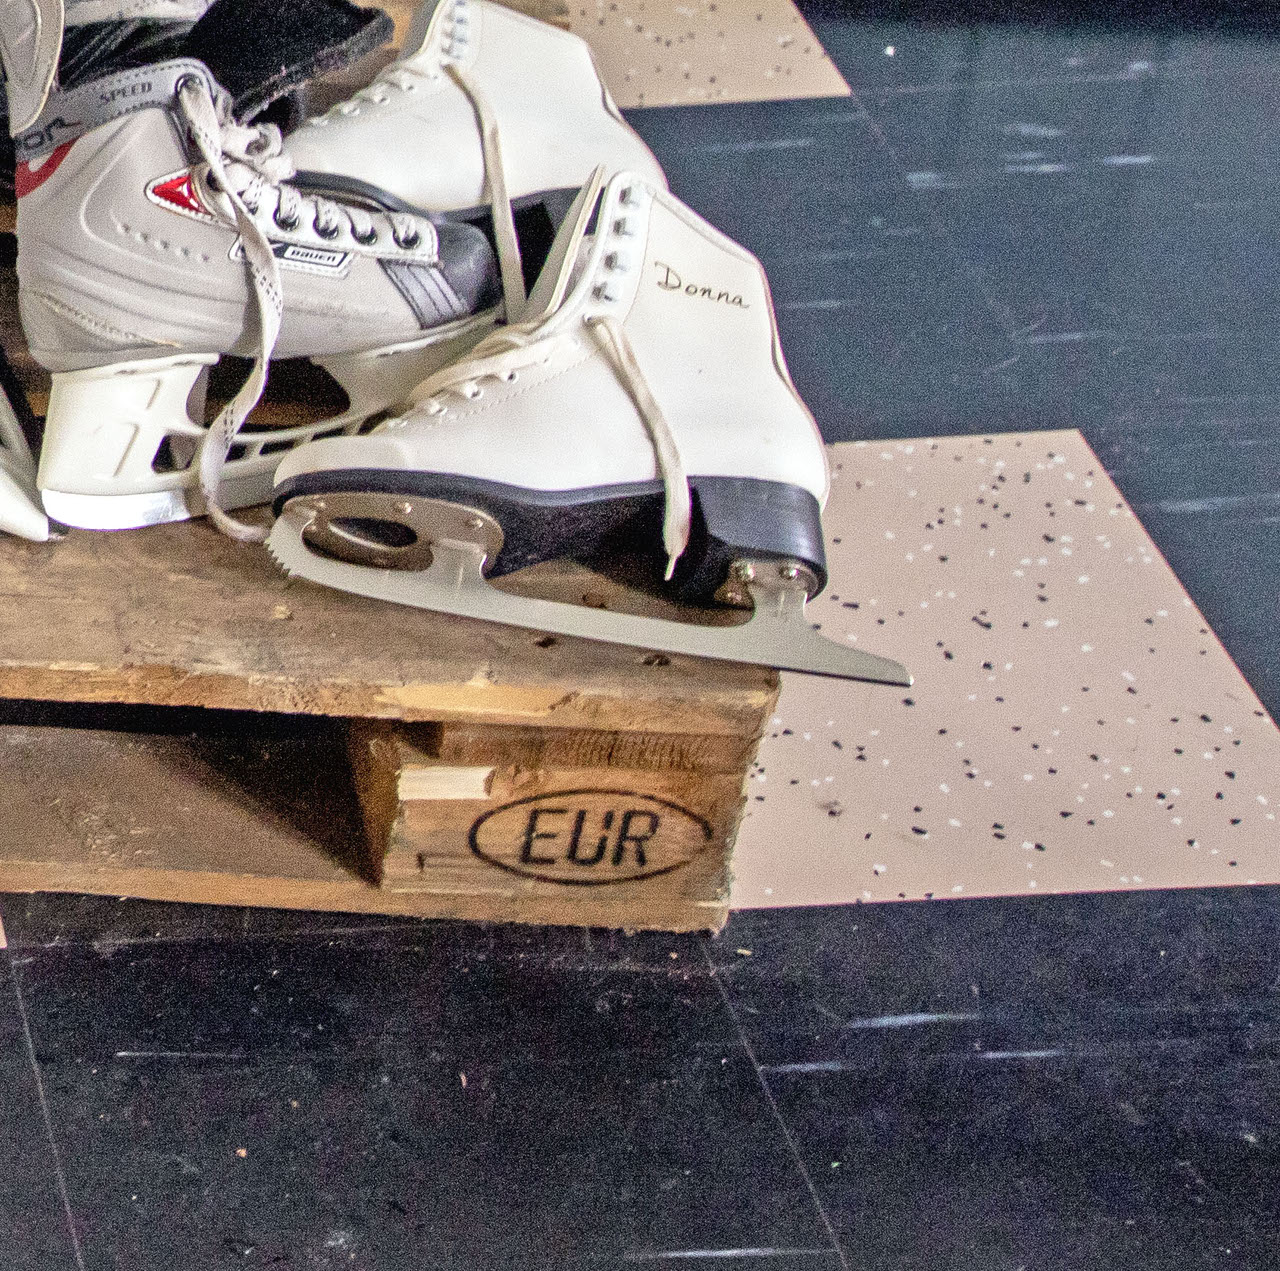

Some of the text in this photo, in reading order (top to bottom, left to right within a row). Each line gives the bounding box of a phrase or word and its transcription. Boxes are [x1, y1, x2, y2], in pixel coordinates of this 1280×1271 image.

[99, 81, 152, 105] SPEED
[654, 261, 750, 308] Donna
[520, 809, 660, 867] EUR
